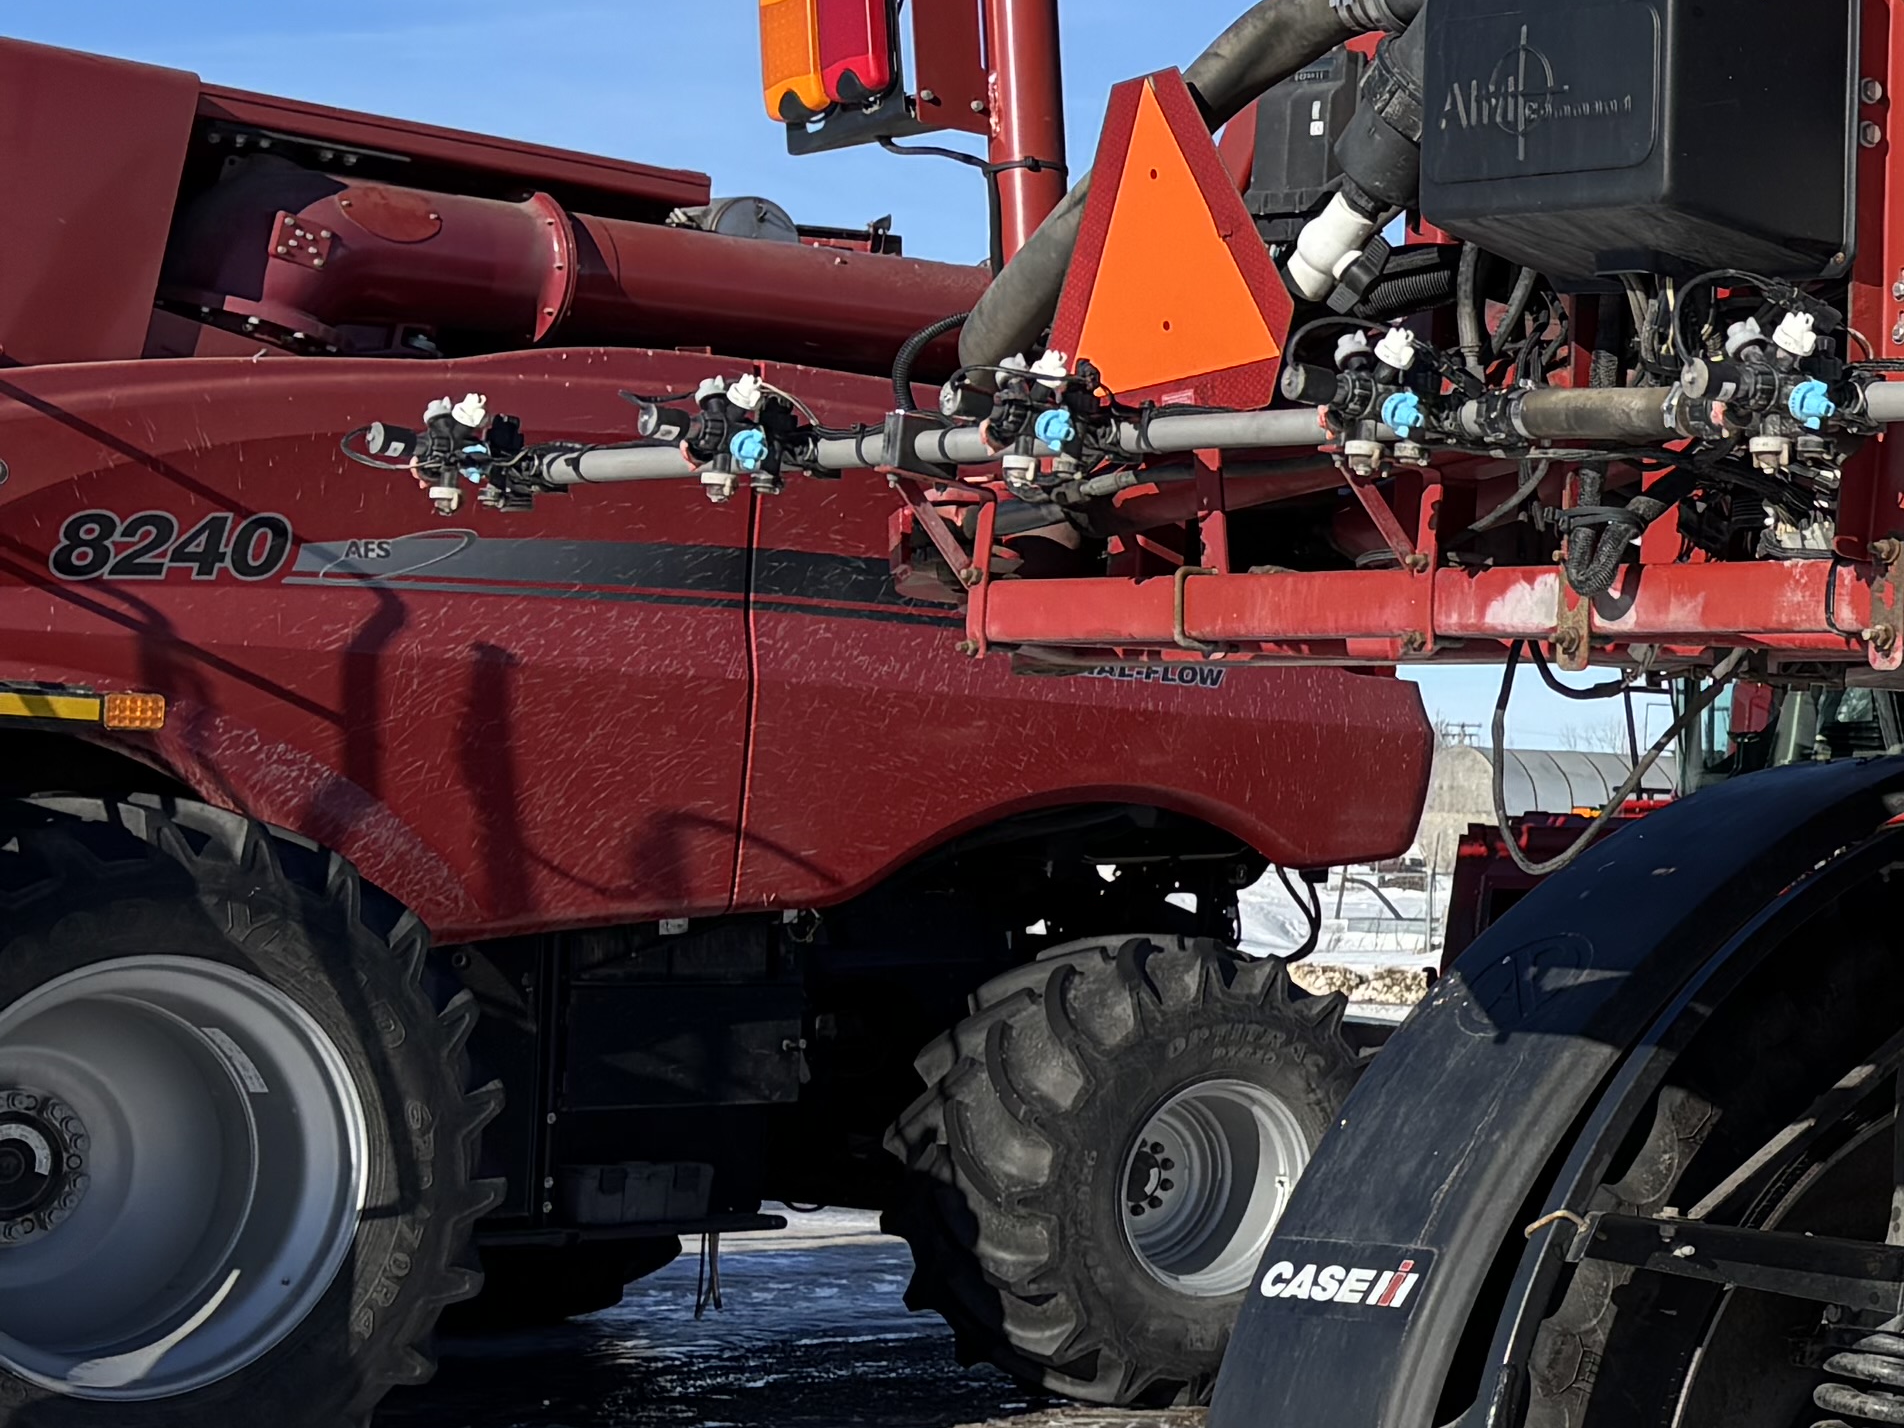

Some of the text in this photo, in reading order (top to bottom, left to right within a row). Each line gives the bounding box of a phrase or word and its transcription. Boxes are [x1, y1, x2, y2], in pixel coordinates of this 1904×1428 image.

[48, 508, 293, 581] 8240
[343, 539, 392, 560] AFS
[1260, 1259, 1420, 1309] CASE IH
